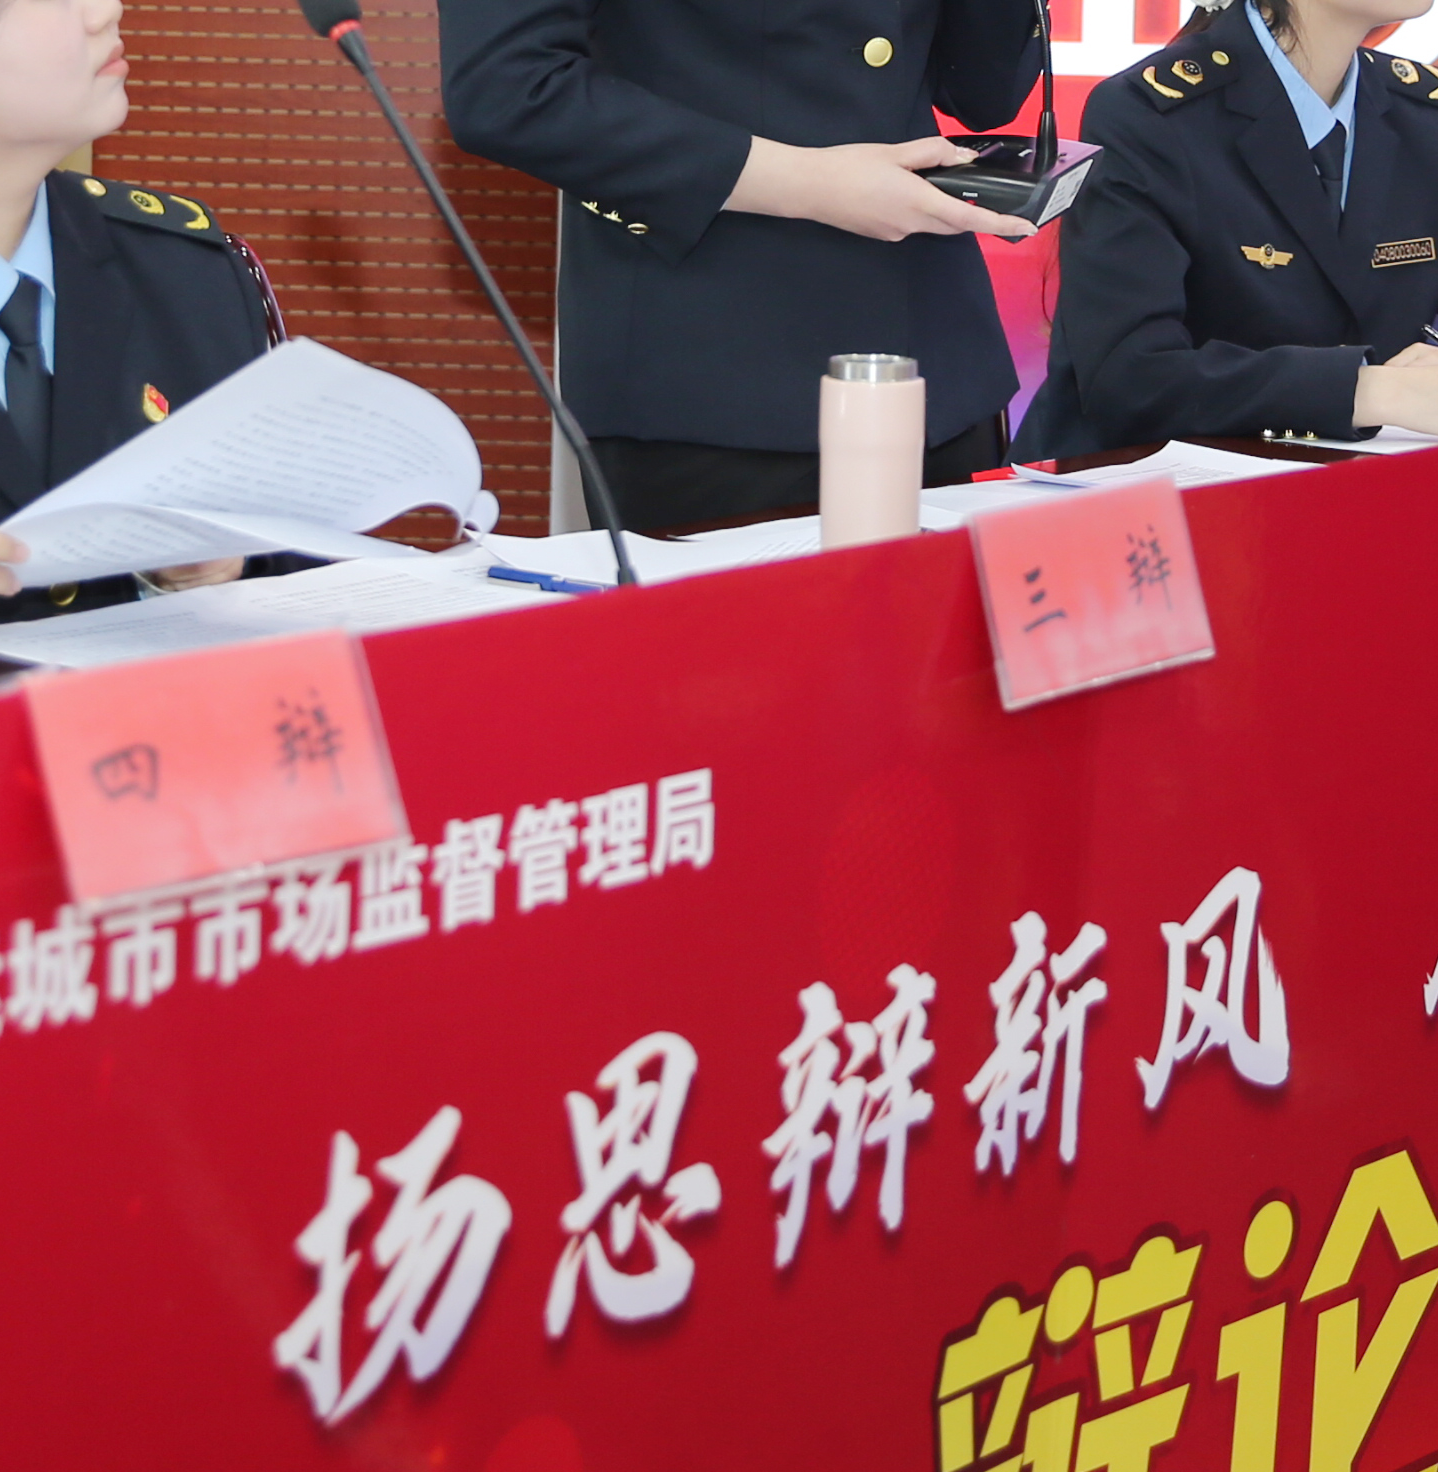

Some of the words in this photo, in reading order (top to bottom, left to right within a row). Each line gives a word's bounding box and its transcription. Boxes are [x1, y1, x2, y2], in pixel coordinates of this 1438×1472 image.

[274, 866, 1292, 1428] 扬思辩新风
